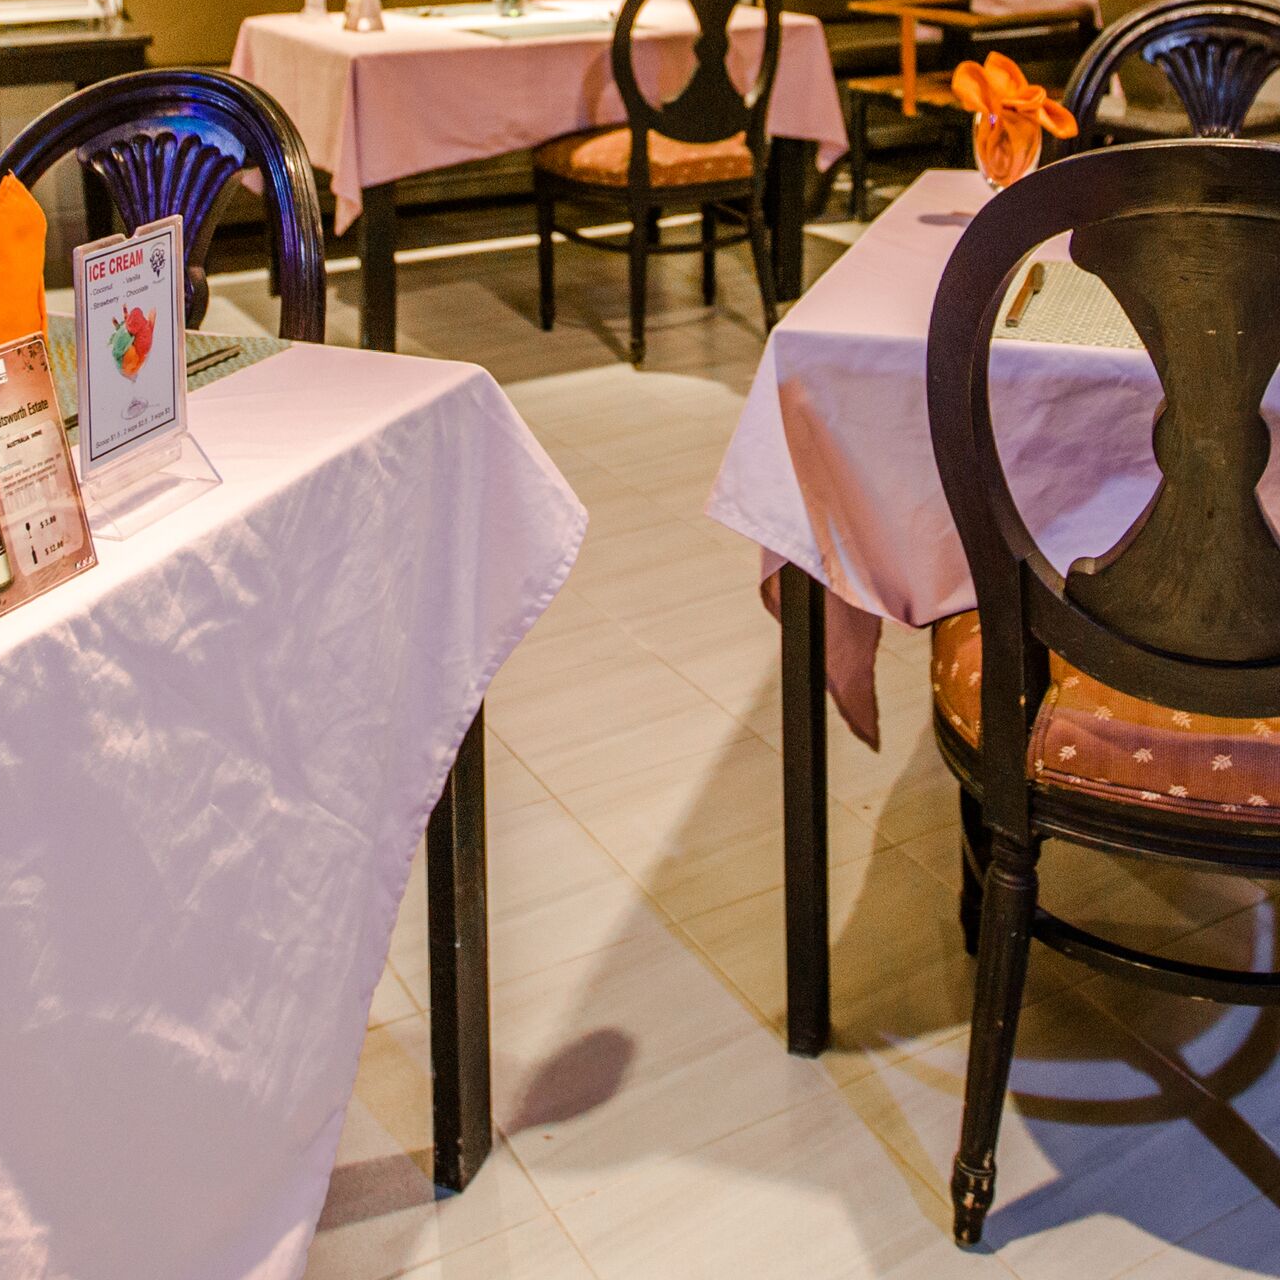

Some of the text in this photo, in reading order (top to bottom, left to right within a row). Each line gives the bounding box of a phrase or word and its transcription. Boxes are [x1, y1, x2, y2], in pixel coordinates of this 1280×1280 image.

[89, 249, 144, 282] ICE CREAM
[92, 283, 113, 296] Coconut
[93, 296, 119, 310] Strawberry
[27, 399, 49, 416] Estate
[7, 435, 30, 449] AUSTRALIA
